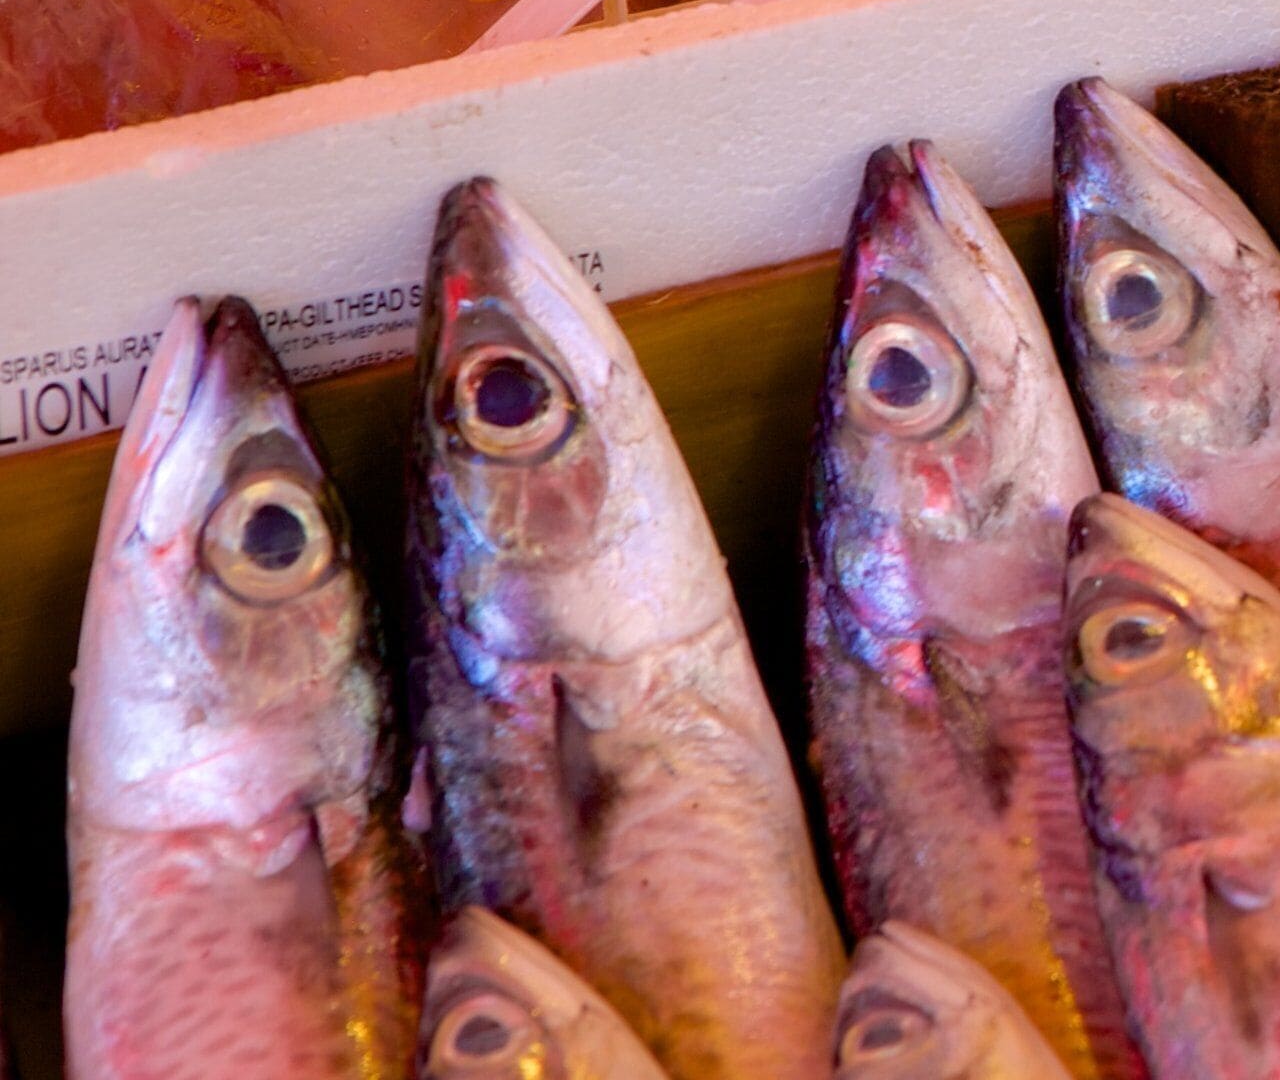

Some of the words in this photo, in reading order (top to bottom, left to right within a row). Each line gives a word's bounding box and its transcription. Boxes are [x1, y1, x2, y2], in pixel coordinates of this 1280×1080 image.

[0, 346, 87, 384] SPARUS
[258, 286, 405, 336] PA-GILTHEAD
[0, 372, 110, 445] ION
